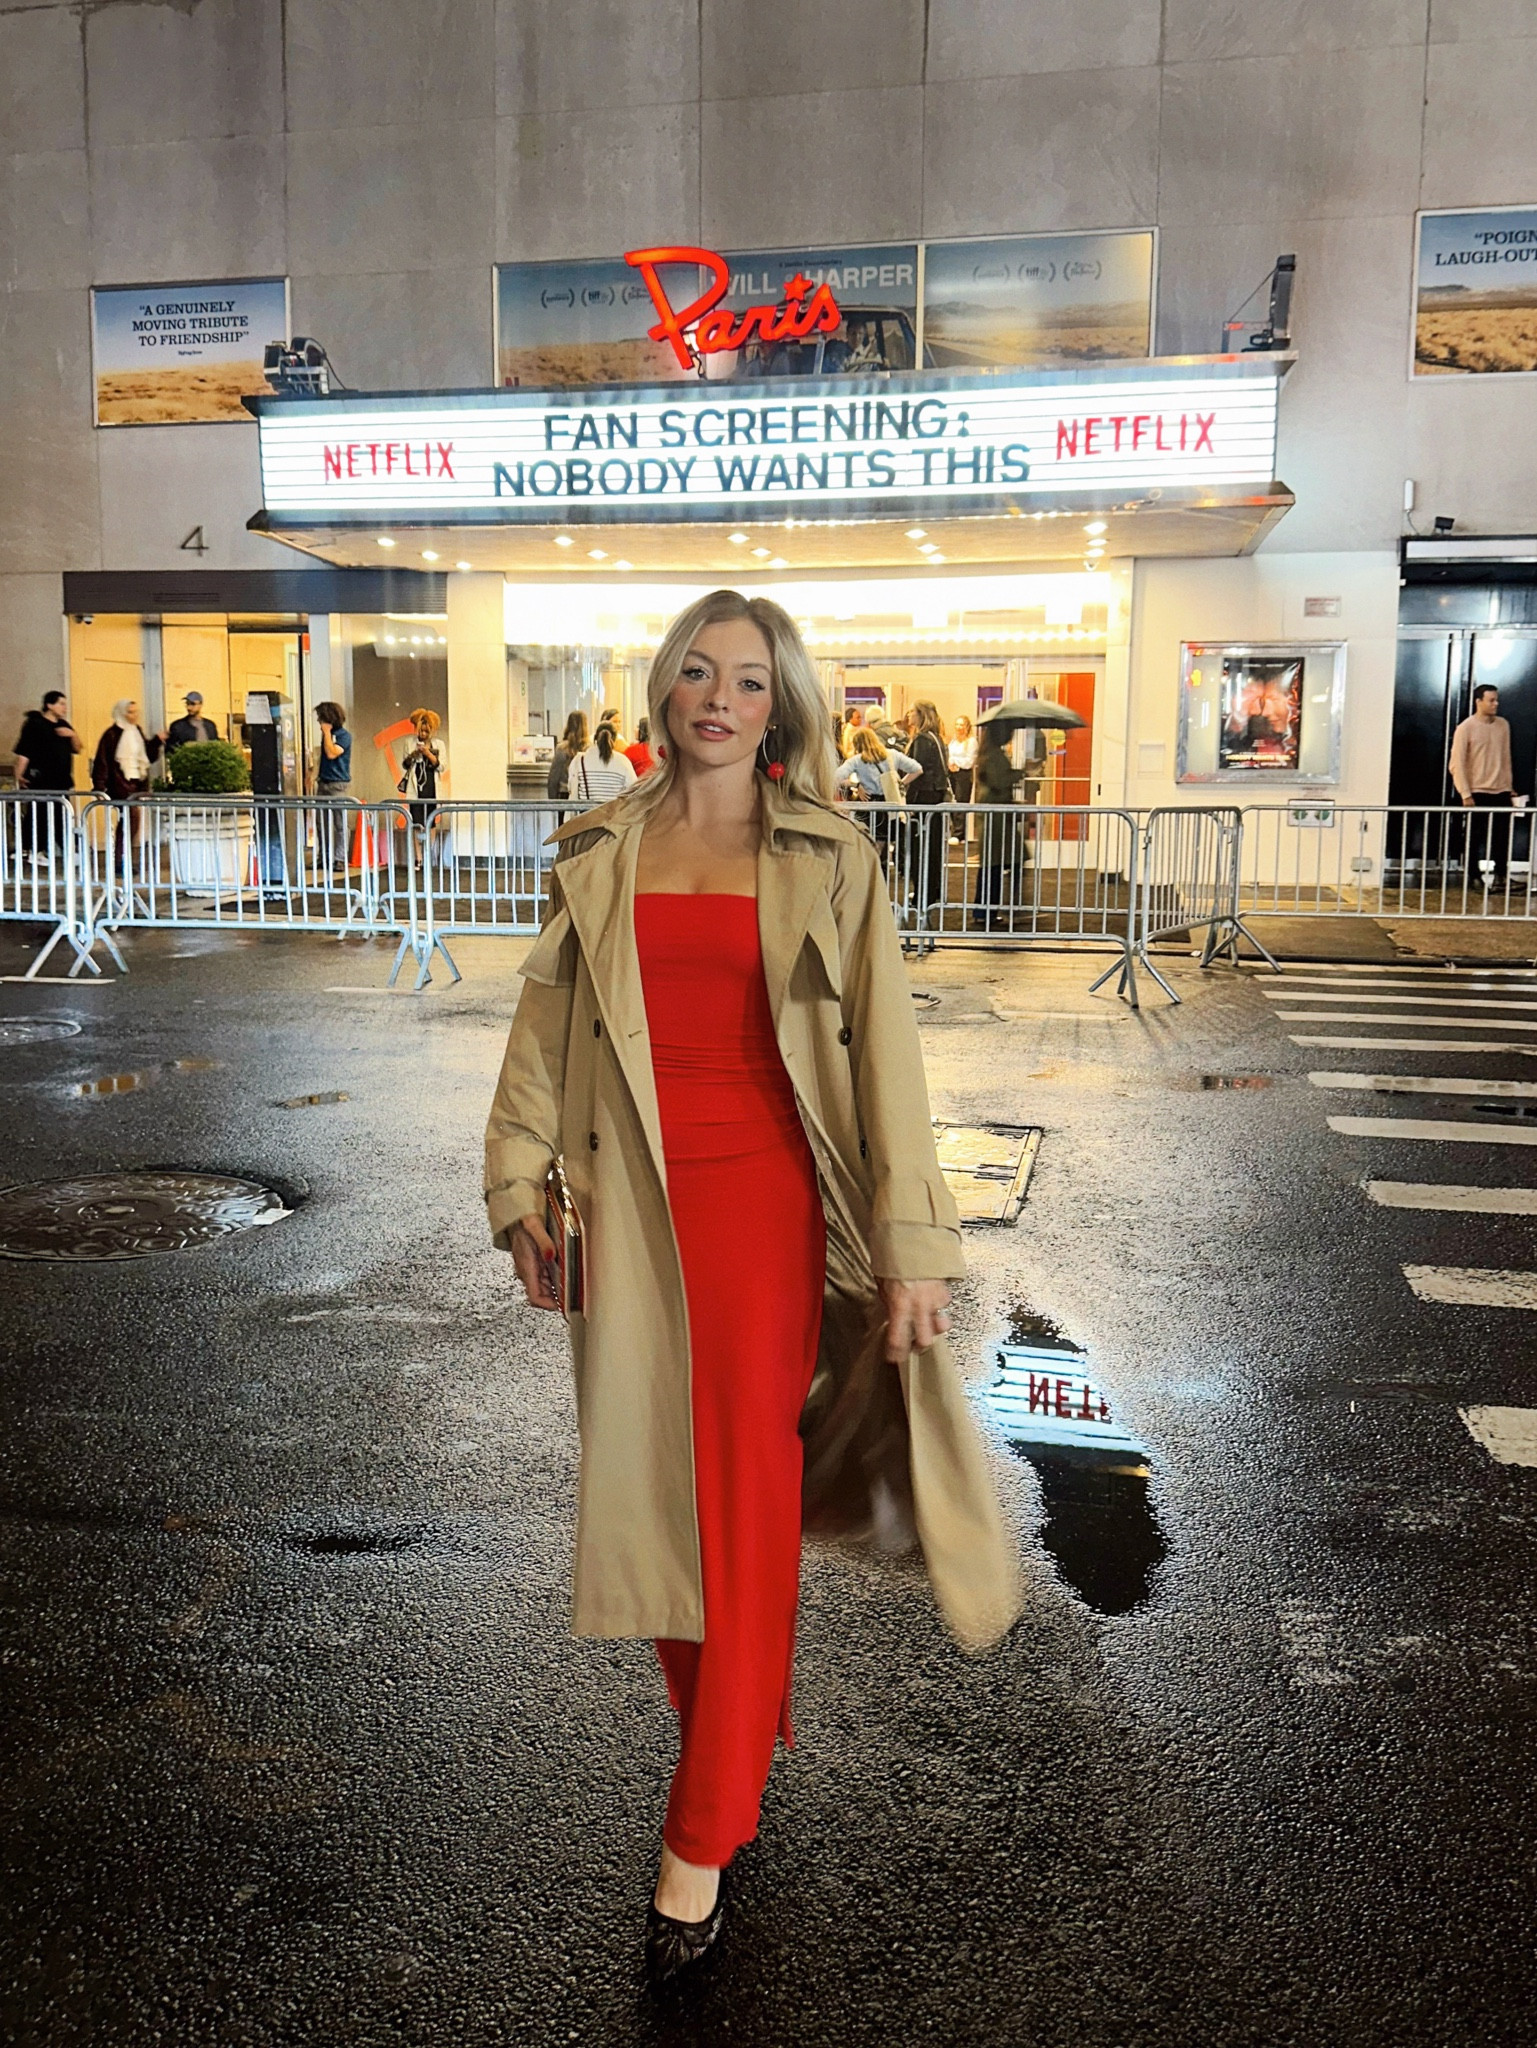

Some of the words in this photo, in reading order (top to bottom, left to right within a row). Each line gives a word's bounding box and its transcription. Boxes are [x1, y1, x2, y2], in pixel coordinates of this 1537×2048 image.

[805, 264, 913, 290] HARPER
[132, 319, 187, 332] MOVING
[189, 315, 248, 329] TRIBUTE
[156, 301, 235, 316] GENUINELY
[624, 246, 841, 370] Paris
[139, 335, 157, 346] TO
[544, 412, 638, 451] FAN
[659, 399, 970, 446] SCREENING:
[1056, 412, 1217, 462] NETFLIX
[323, 442, 455, 482] NETFLIX
[494, 454, 698, 498] NOBODY
[713, 448, 897, 492] WANTS
[912, 442, 1031, 486] THIS
[180, 525, 210, 557] 4
